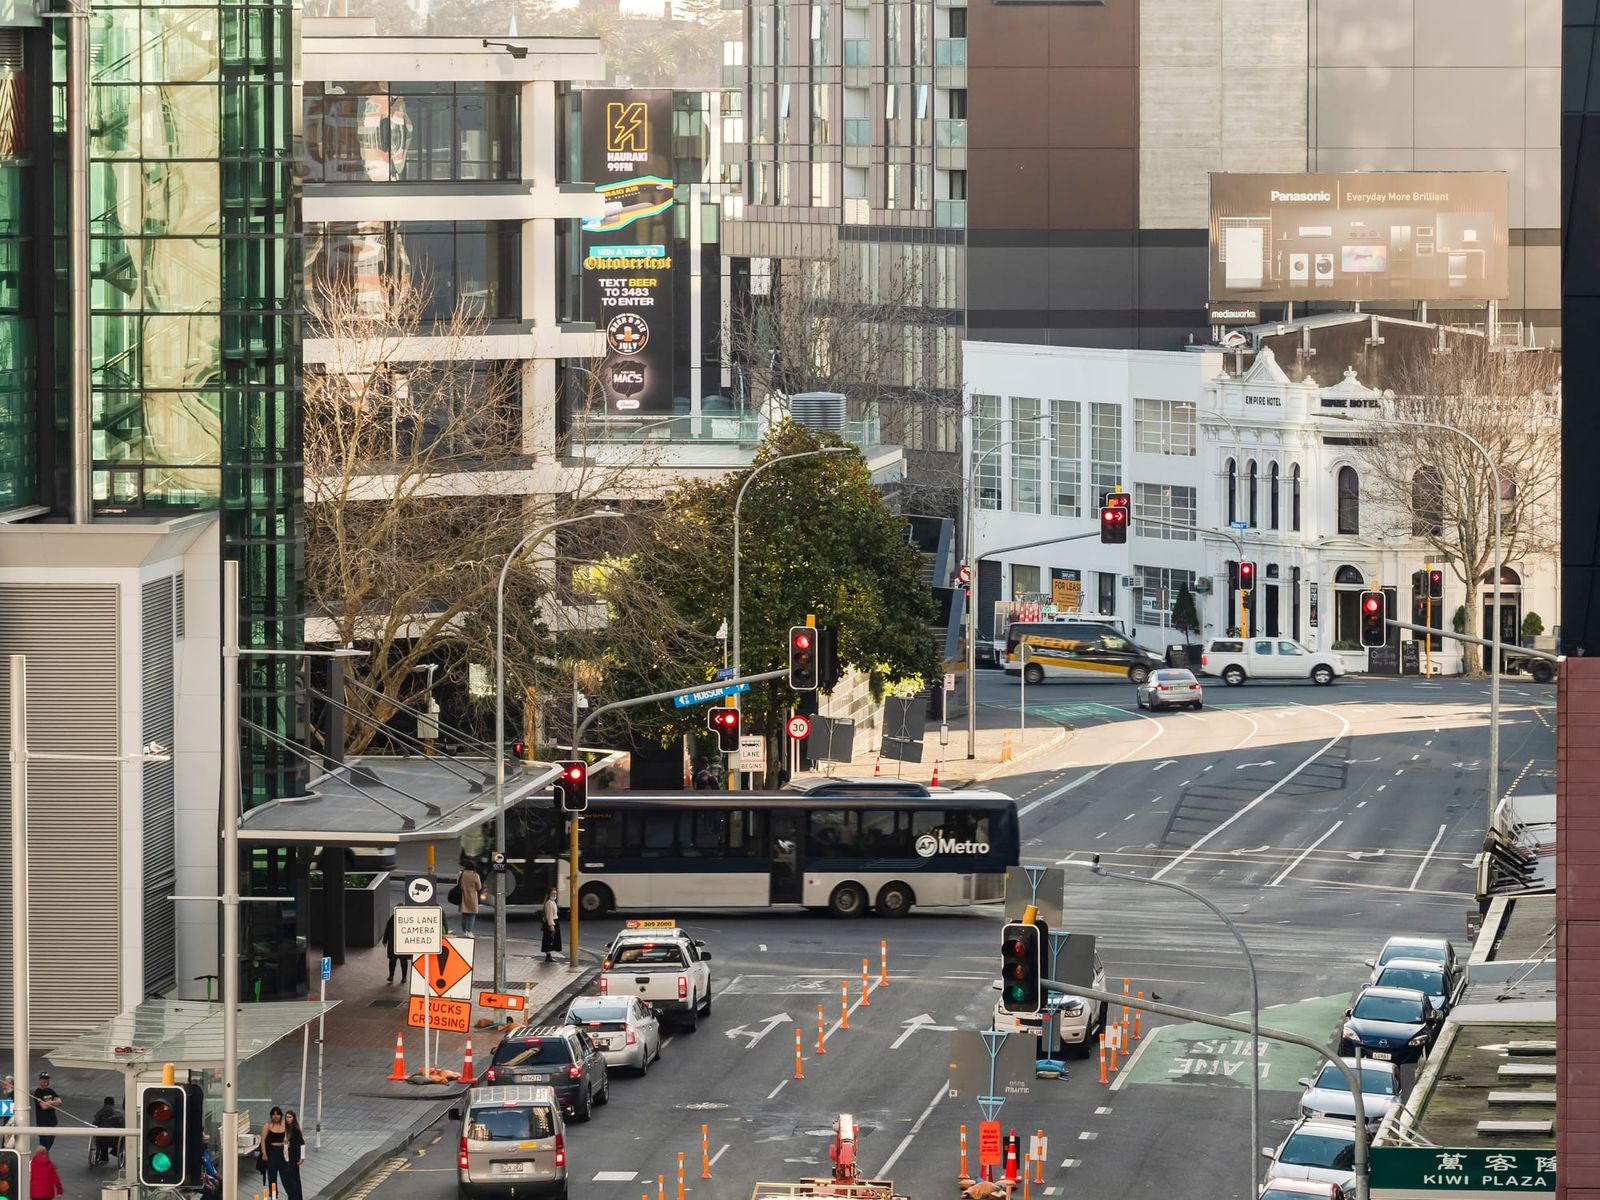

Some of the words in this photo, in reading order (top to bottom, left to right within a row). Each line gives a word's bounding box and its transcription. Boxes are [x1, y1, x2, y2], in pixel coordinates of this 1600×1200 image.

[607, 152, 648, 162] HAURAKI
[607, 162, 633, 172] 99FM
[1271, 190, 1331, 202] Panasonic
[1346, 192, 1386, 203] Everyday
[1388, 193, 1411, 201] More
[1412, 192, 1449, 201] Brilliant
[597, 248, 614, 256] WIN
[616, 248, 623, 256] A
[624, 248, 644, 256] TRIP
[645, 248, 658, 256] TO
[583, 256, 672, 270] Oktoberfest
[598, 278, 628, 287] TEXT
[628, 278, 657, 287] BEER
[604, 288, 620, 297] TO
[621, 288, 649, 296] 3483
[601, 297, 617, 306] TO
[618, 297, 654, 306] ENTER
[1211, 310, 1256, 319] mediaworks
[610, 317, 627, 333] BEER
[634, 319, 647, 333] PIE
[618, 342, 638, 350] JULY
[1266, 396, 1282, 407] HOTEL
[1349, 398, 1381, 408] HOTEL
[1055, 581, 1066, 590] FOR
[792, 723, 805, 732] 30
[938, 838, 990, 855] Metro
[398, 916, 414, 924] BUS
[417, 916, 438, 924] LANE
[401, 926, 435, 934] CAMERA
[404, 937, 432, 945] AHEAD
[1423, 1174, 1469, 1185] KIWI
[1482, 1175, 1547, 1187] PLAZA
